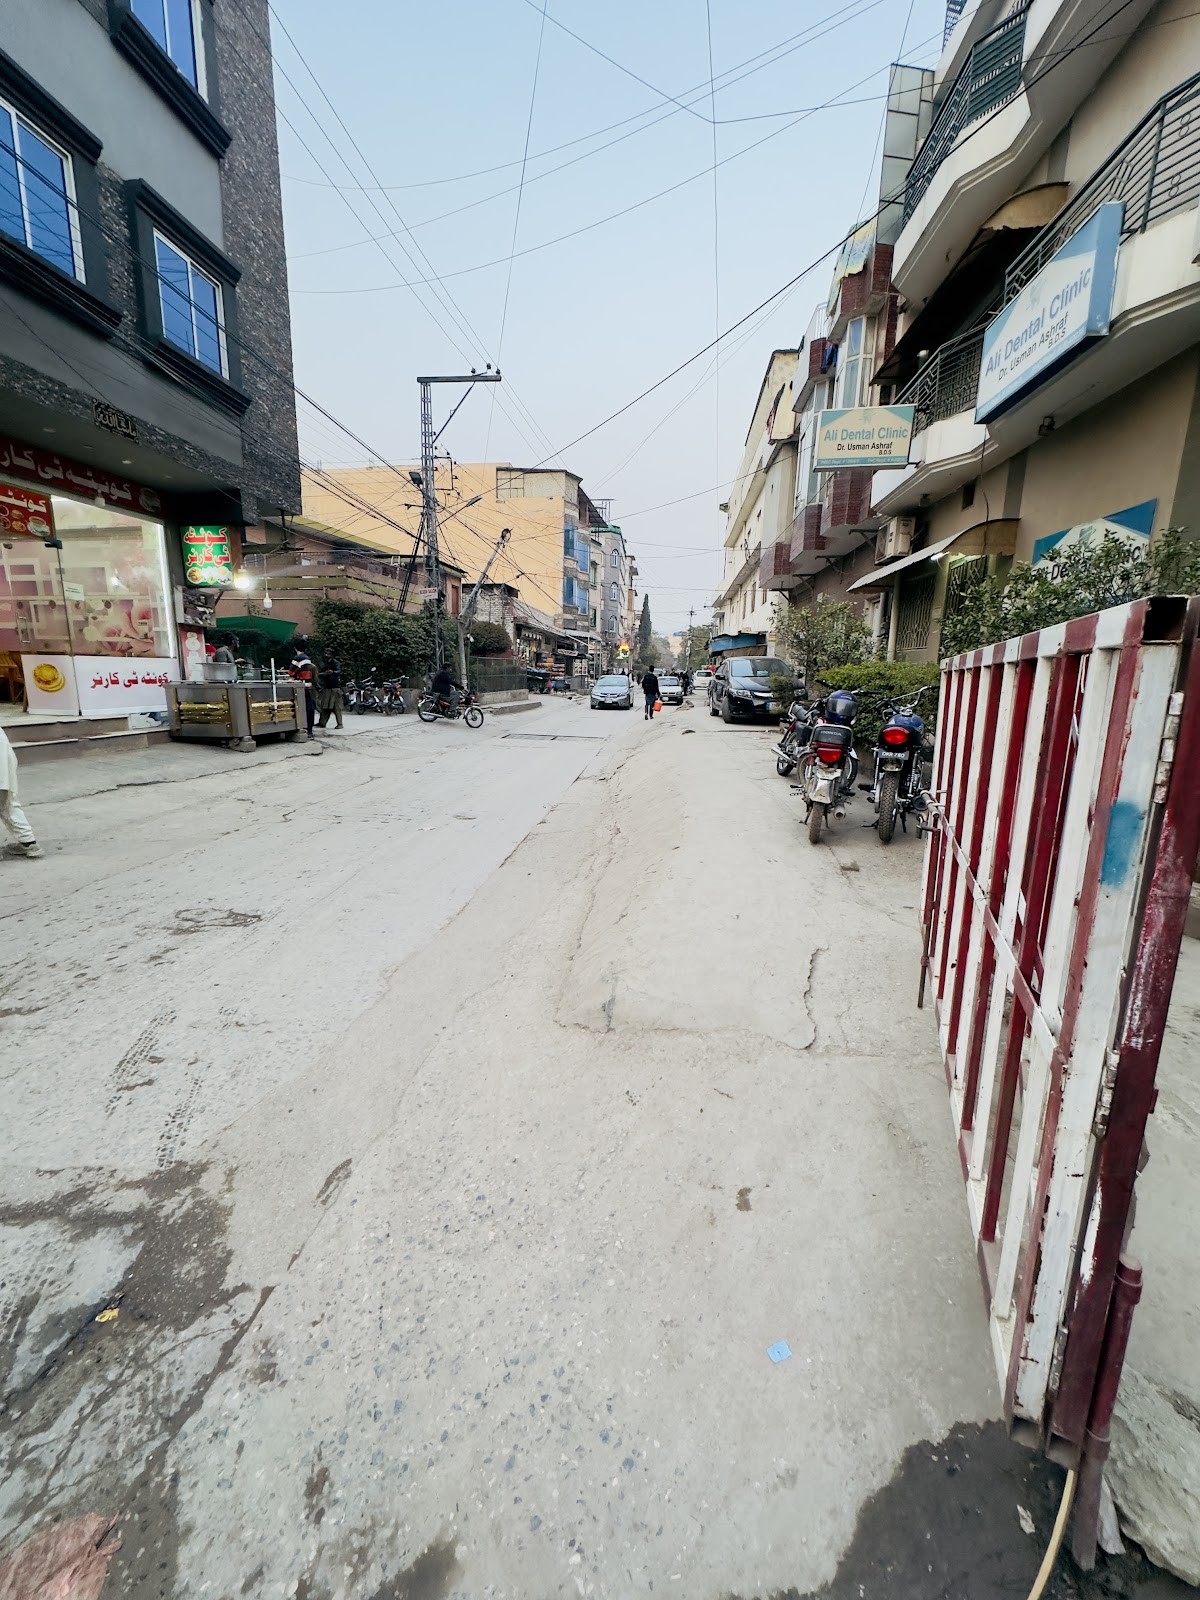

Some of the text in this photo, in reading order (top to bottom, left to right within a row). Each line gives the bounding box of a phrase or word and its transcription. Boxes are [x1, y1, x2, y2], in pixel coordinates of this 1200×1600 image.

[985, 267, 1091, 376] Ali Dental Clinic
[998, 369, 1008, 381] Dr.
[1010, 342, 1037, 371] Usman
[1038, 311, 1069, 346] Ashraf
[824, 426, 909, 441] Ali Dental Clinic
[836, 441, 893, 451] Dr. Usman Ashraf
[90, 671, 120, 689] کارنر
